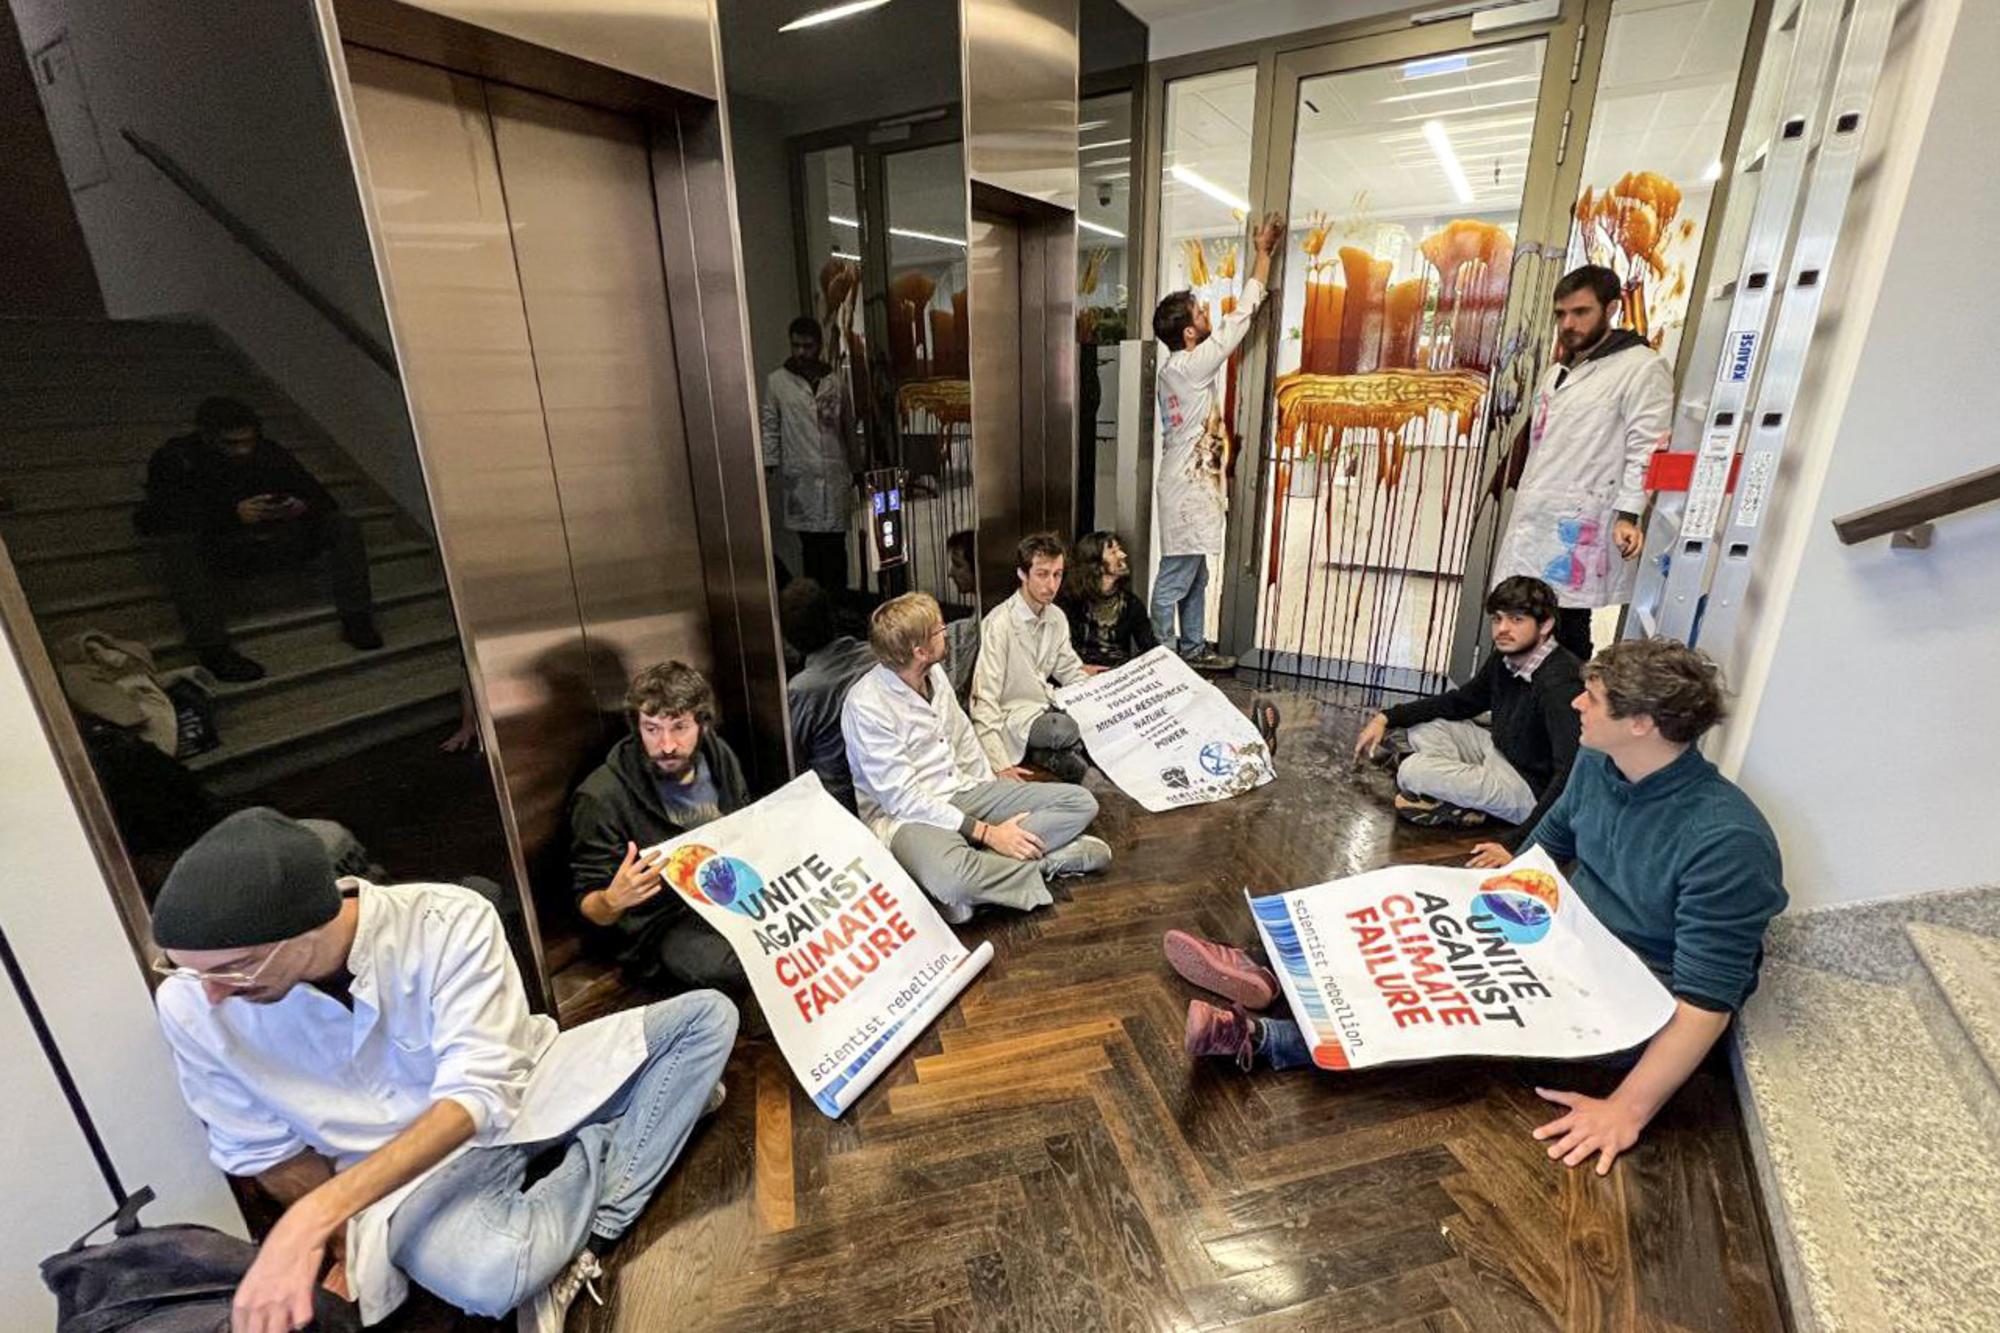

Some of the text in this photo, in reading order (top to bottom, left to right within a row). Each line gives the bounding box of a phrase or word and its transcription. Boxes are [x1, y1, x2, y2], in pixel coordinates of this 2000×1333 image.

[1732, 333, 1755, 381] KRAUSE
[1096, 707, 1135, 733] MINERAL
[1135, 682, 1189, 713] RESSOURCES
[1133, 706, 1168, 729] NATURE
[1137, 680, 1163, 696] FUELS
[1154, 727, 1188, 749] POWER
[738, 853, 832, 922] UNITE
[752, 857, 872, 955] AGAINST
[775, 882, 899, 987] CLIMATE
[793, 911, 917, 1023] FAILURE
[1294, 898, 1328, 968] scientist
[1346, 906, 1434, 1029] FAILURE
[1381, 894, 1481, 1028] CLIMATE
[1415, 890, 1525, 1028] AGAINST
[1466, 913, 1552, 1000] UNITE
[811, 1015, 886, 1082] scientist
